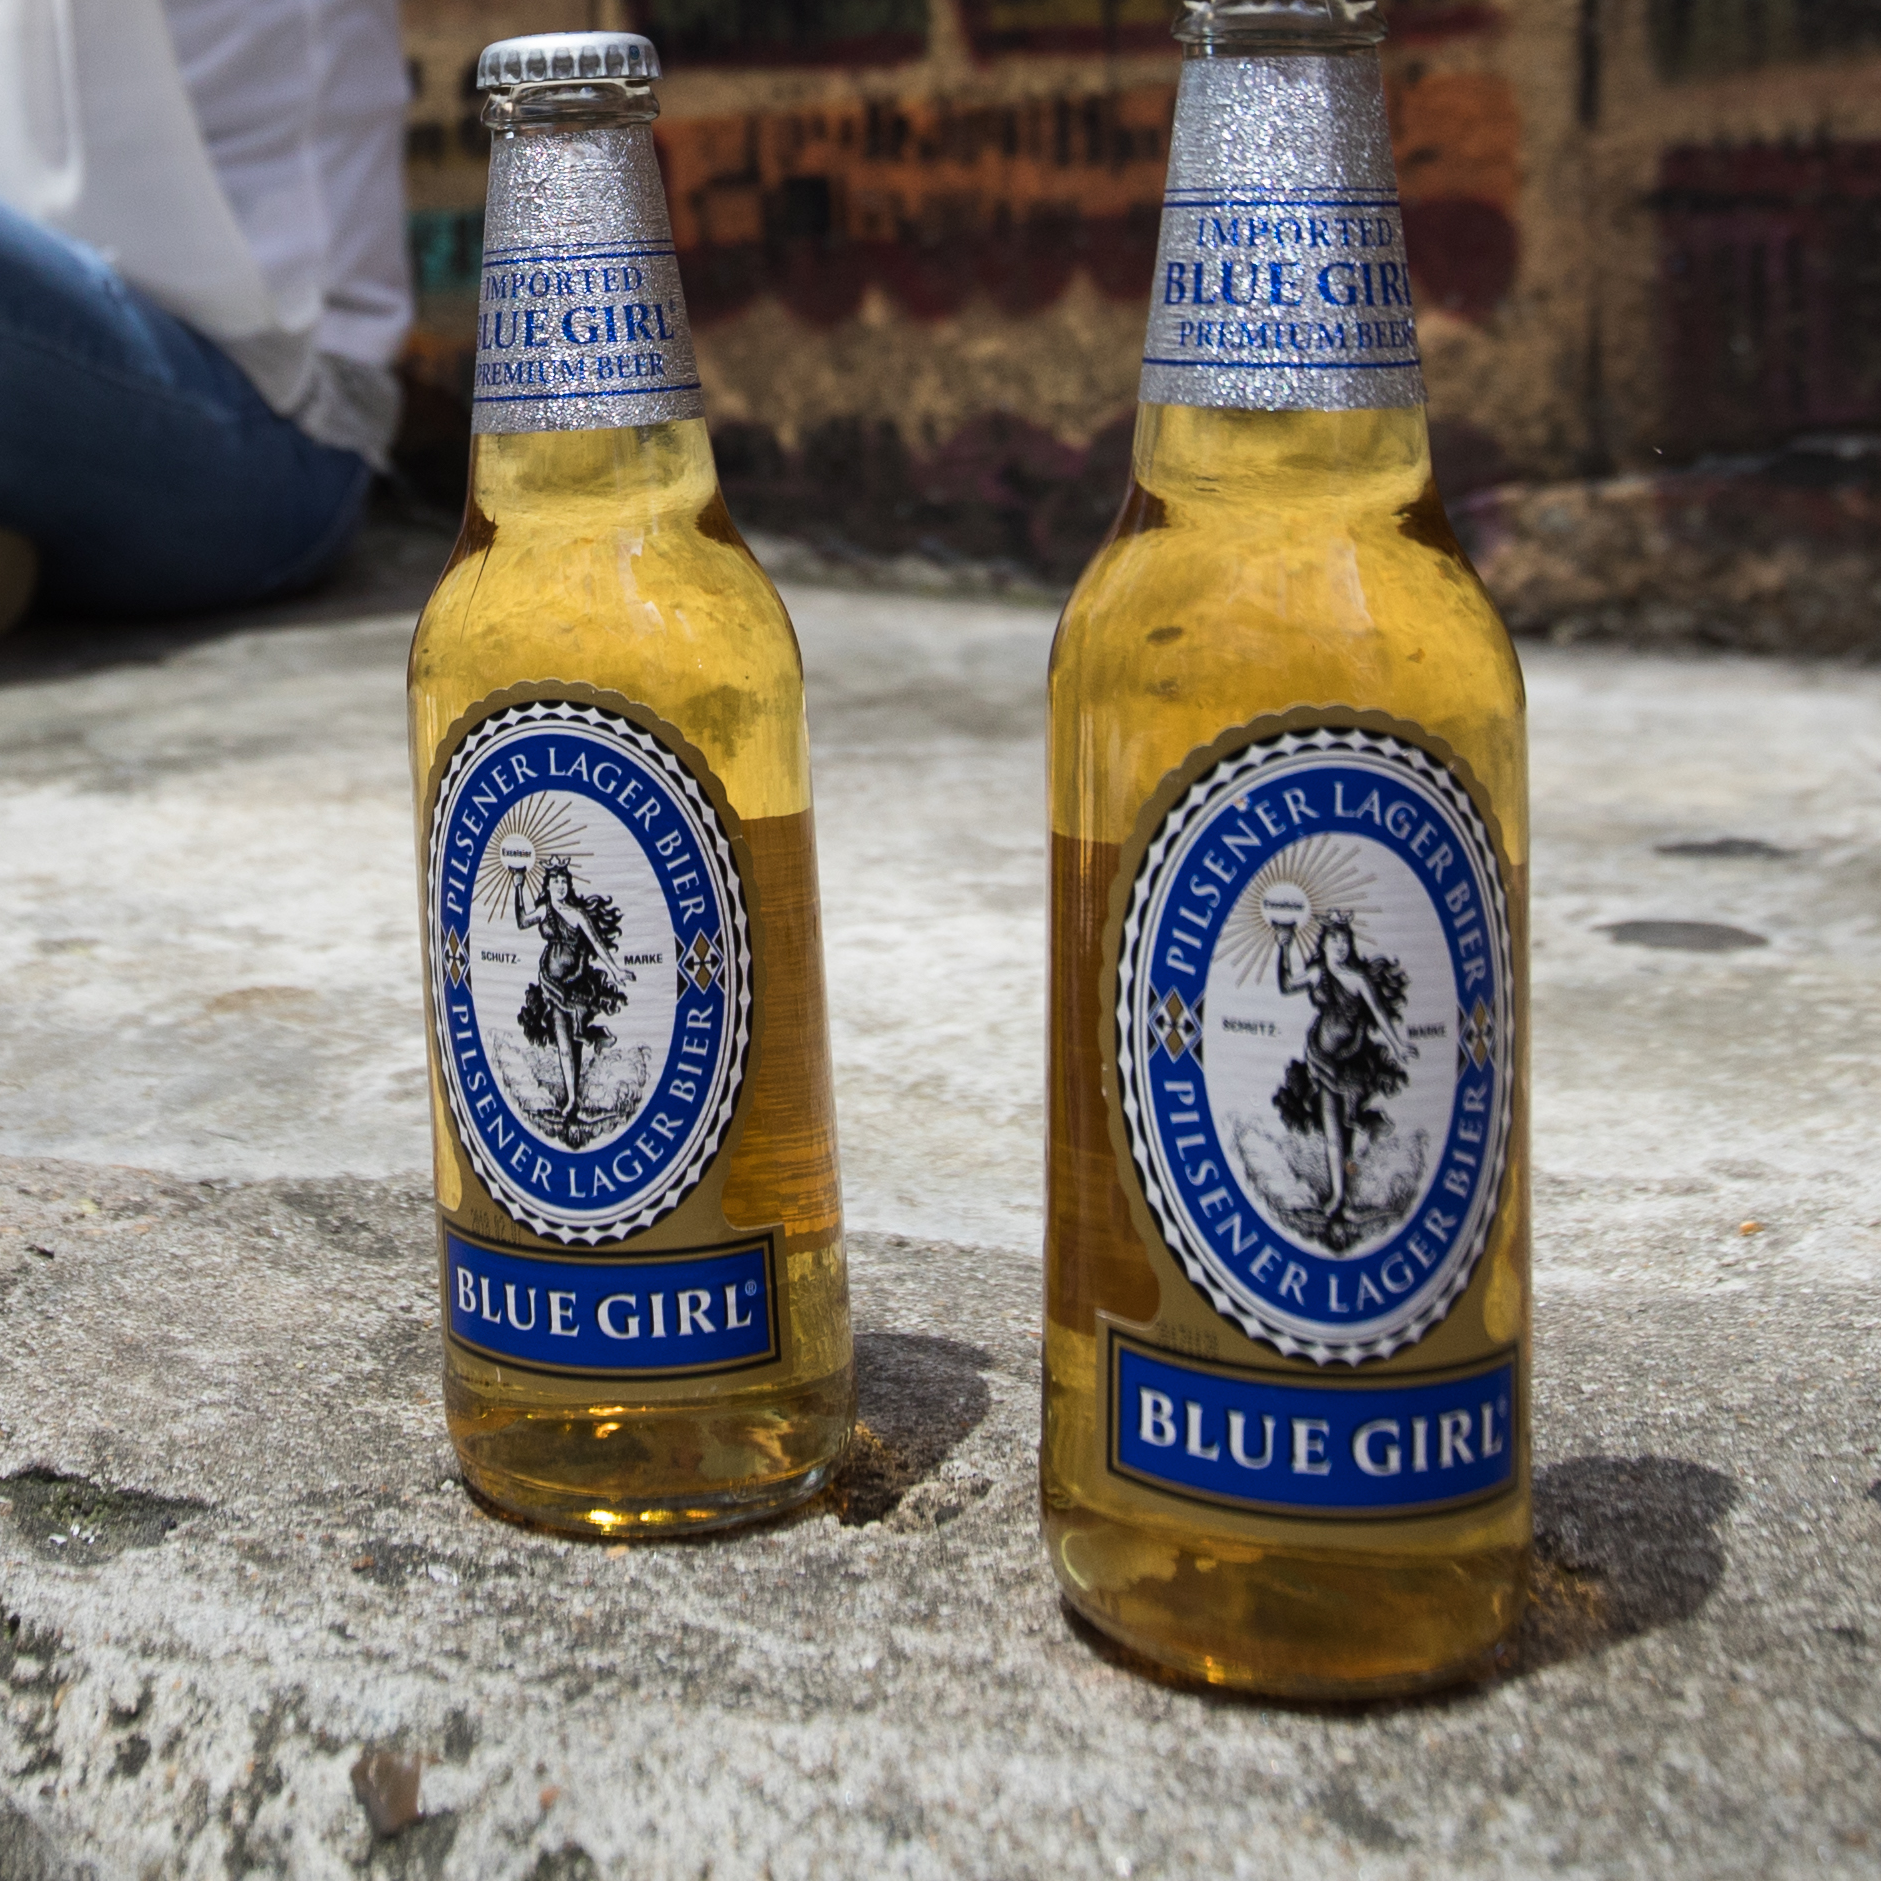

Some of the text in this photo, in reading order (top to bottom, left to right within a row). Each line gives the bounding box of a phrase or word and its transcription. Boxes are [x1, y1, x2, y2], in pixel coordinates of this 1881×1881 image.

[1197, 217, 1392, 248] IMPORTED
[485, 266, 642, 301] IMPORTED
[1164, 261, 1303, 306] BLUE
[1179, 320, 1347, 349] PREMIUM
[476, 352, 667, 386] PREMIUM BEER
[446, 747, 706, 924] PILSENER LAGER BIER
[1165, 781, 1487, 991] PILSENER LAGER BIER
[623, 952, 664, 965] MARKE
[451, 1004, 713, 1198] PILSENER LAGER BIER
[1163, 1080, 1488, 1313] PILSENER LAGER BIER
[457, 1266, 580, 1338] BLUE
[1138, 1386, 1333, 1476] BLUE
